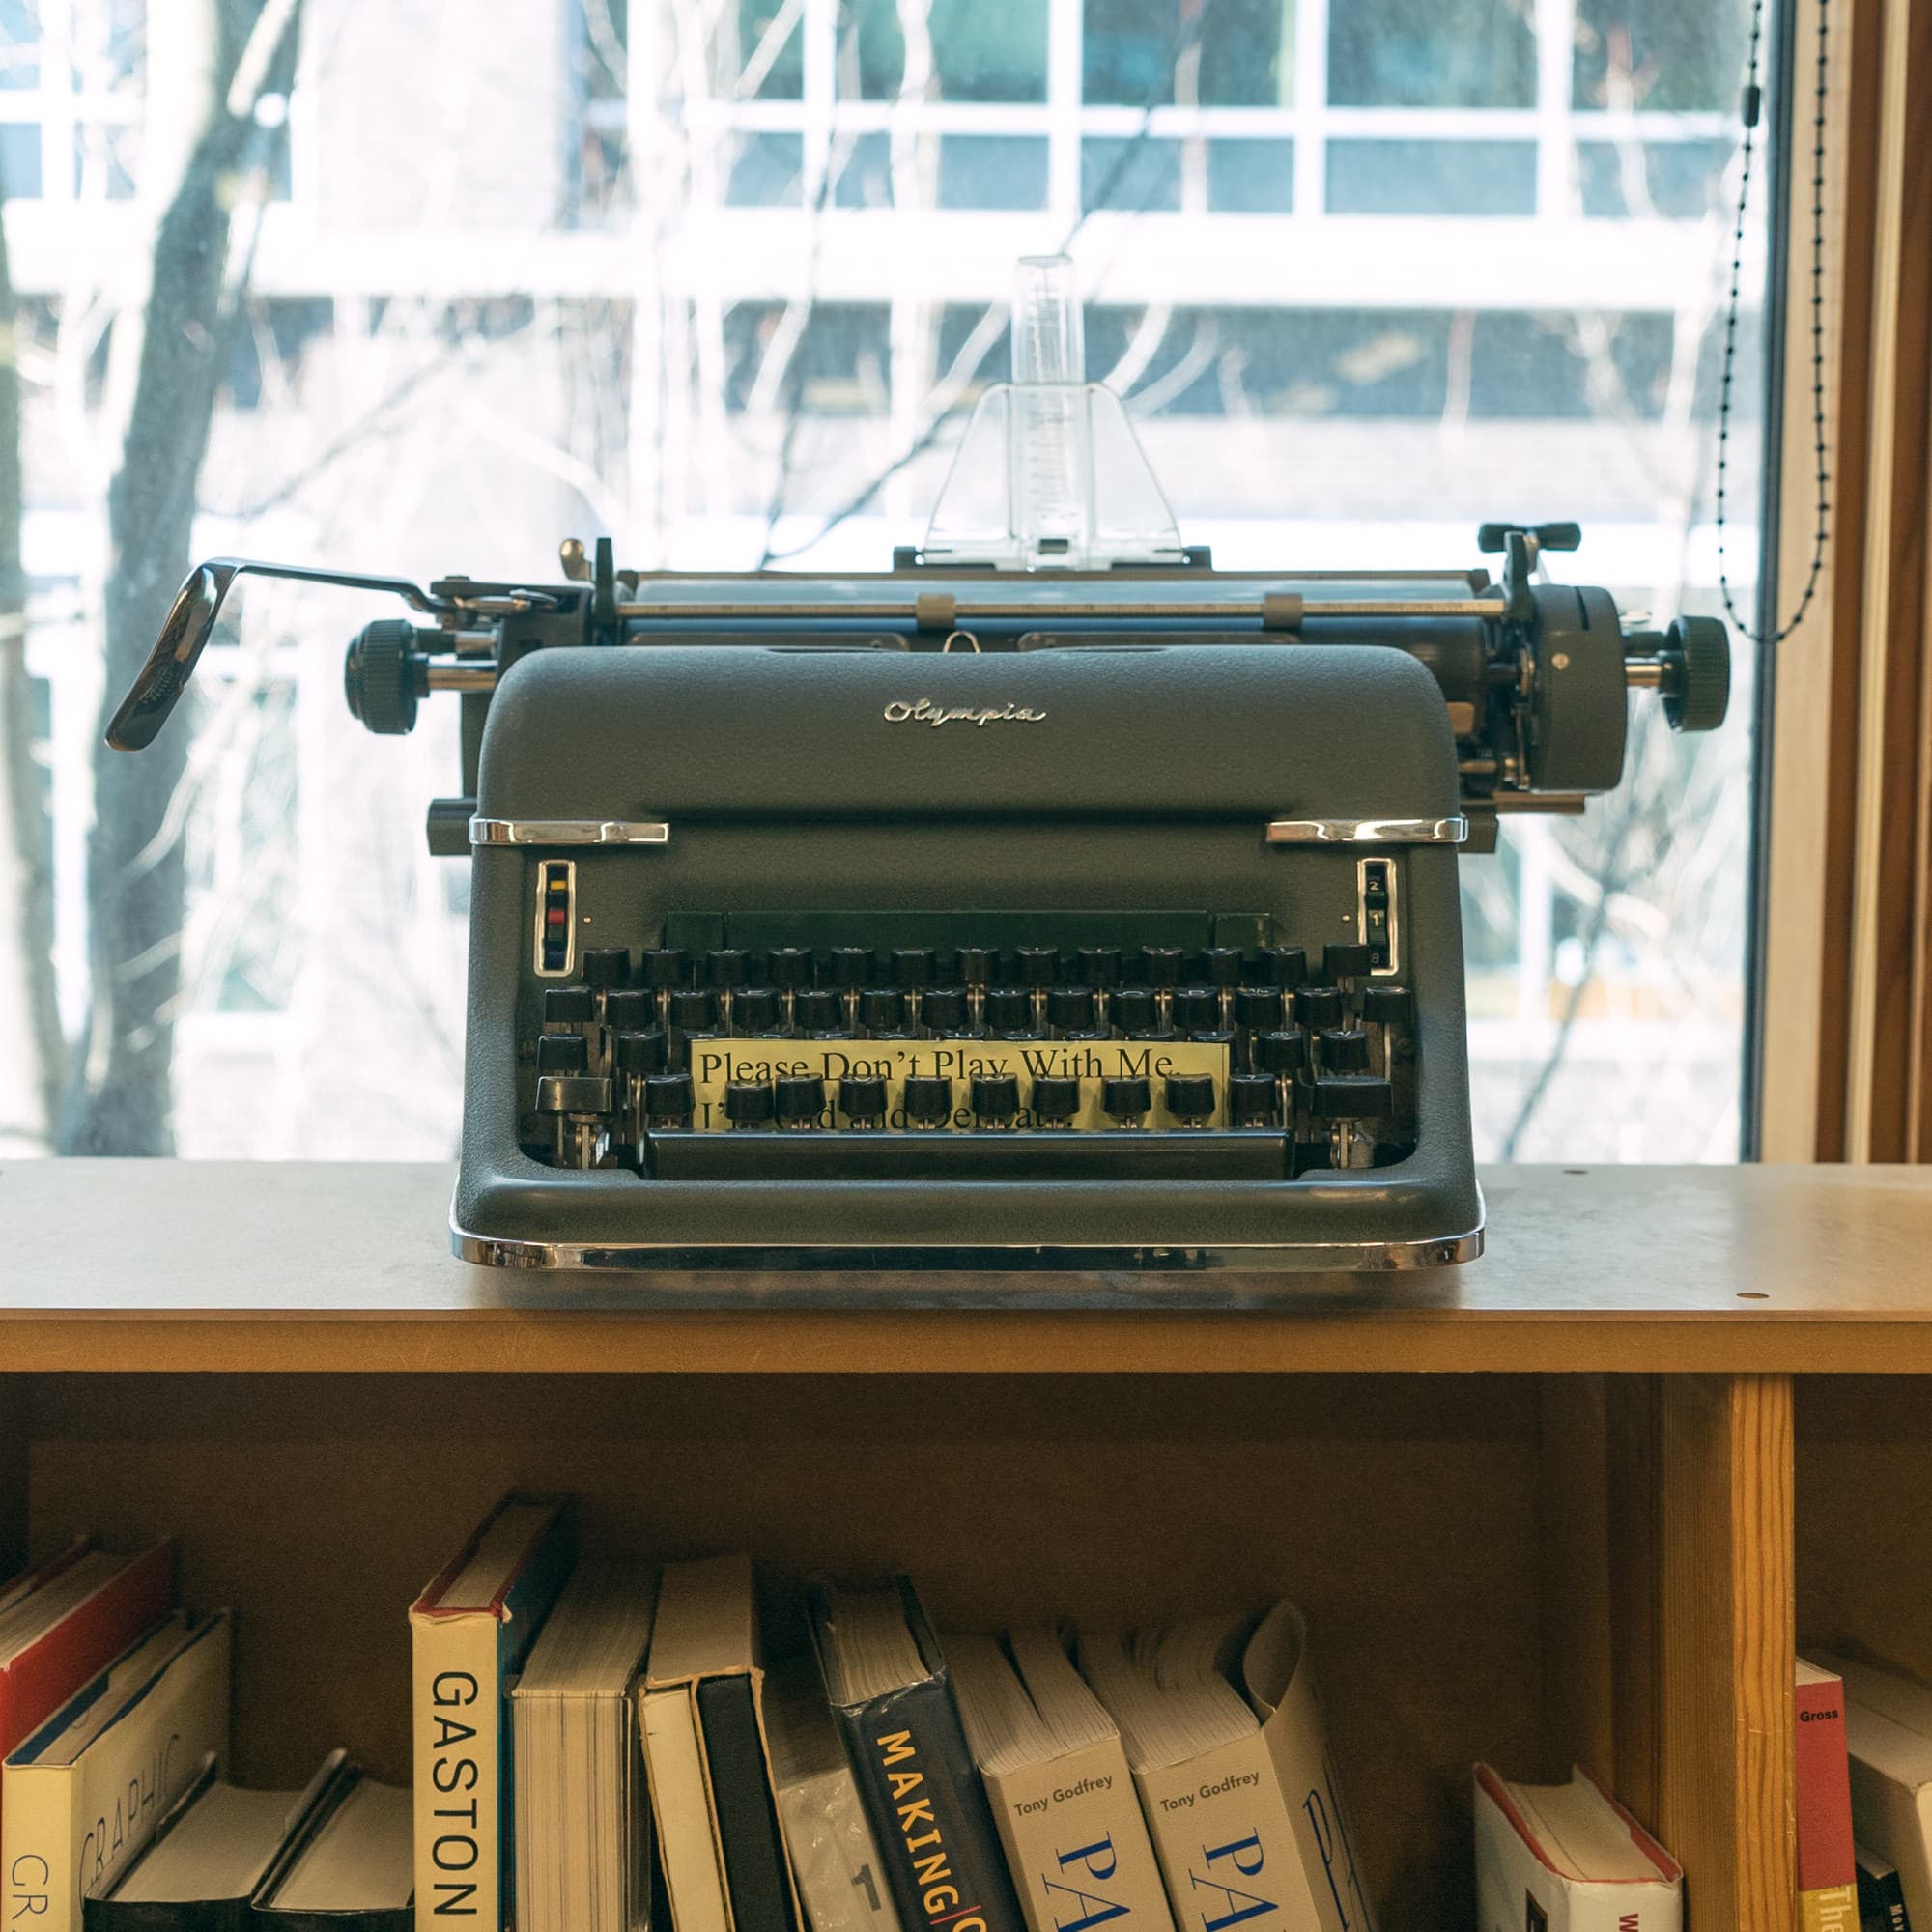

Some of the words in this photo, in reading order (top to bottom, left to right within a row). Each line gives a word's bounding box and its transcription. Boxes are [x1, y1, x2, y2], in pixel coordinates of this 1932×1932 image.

[884, 698, 1047, 727] Olympia
[1369, 881, 1379, 892] 2
[1372, 913, 1379, 927] 1
[698, 1052, 809, 1084] Please
[820, 1050, 921, 1081] Don't
[1019, 1048, 1103, 1079] With
[1800, 1710, 1839, 1722] Gross
[432, 1670, 479, 1918] GASTON
[1013, 1797, 1048, 1817] Tony
[1052, 1776, 1113, 1803] Godfrey
[1160, 1794, 1195, 1812] Tony
[1199, 1772, 1259, 1799] Godfrey
[876, 1729, 959, 1915] MAKING
[12, 1854, 49, 1932] GR
[851, 1863, 882, 1912] 1
